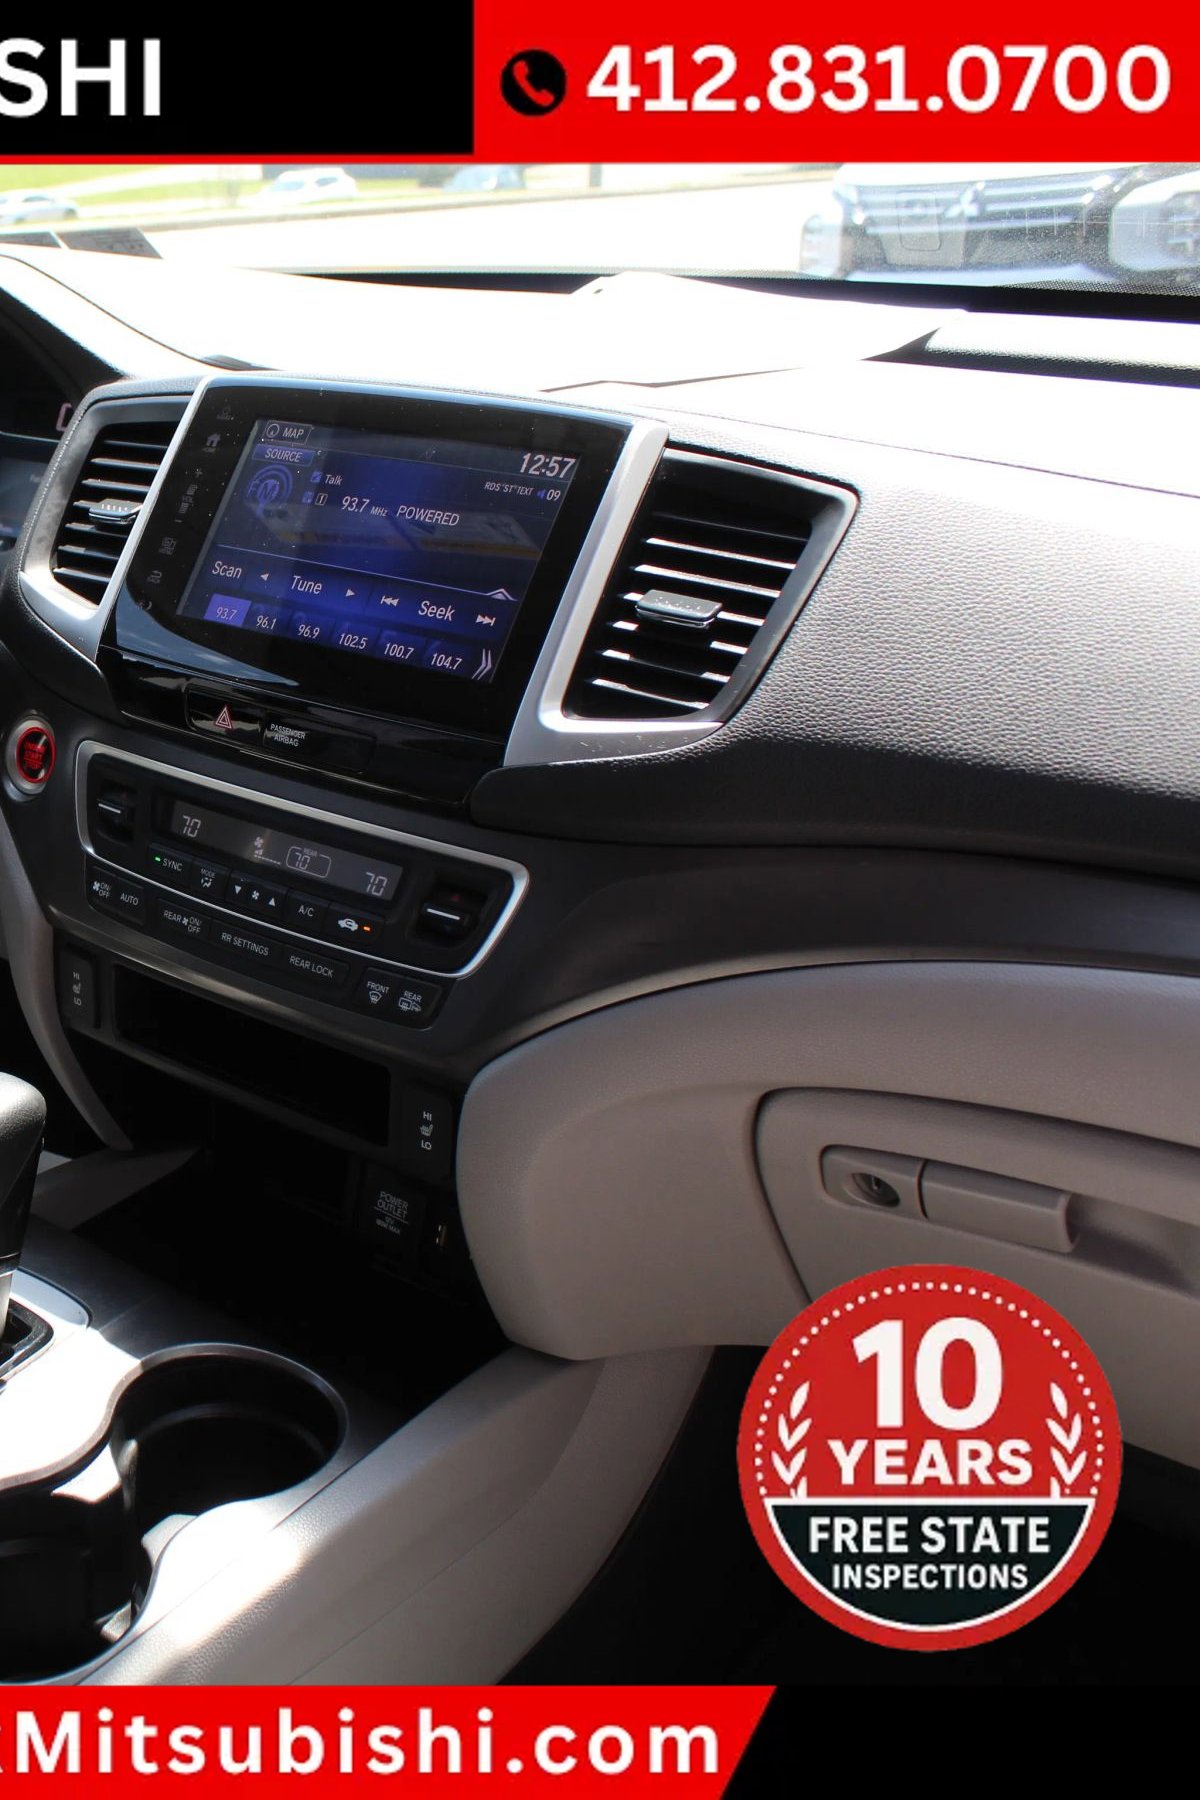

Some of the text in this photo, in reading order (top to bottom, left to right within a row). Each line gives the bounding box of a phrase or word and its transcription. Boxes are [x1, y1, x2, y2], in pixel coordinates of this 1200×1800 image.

[282, 427, 304, 439] MAP
[265, 448, 304, 463] SOURCE
[519, 452, 576, 479] 12:57
[324, 474, 343, 486] Talk
[546, 489, 561, 501] 09
[341, 496, 369, 513] 93.7
[370, 506, 389, 517] MHz
[397, 505, 460, 527] POWERED
[212, 560, 243, 580] Scan
[290, 575, 323, 596] Tune
[215, 606, 238, 621] 93.7
[418, 600, 456, 622] Seek
[256, 615, 277, 630] 96.1
[298, 624, 321, 639] 96.9
[339, 633, 369, 650] 102.5
[383, 642, 414, 660] 100.7
[430, 652, 464, 671] 104.7
[270, 723, 306, 739] PASSENGER
[274, 733, 299, 747] AIRBAG
[182, 815, 201, 838] 70
[162, 858, 183, 872] SYNC
[295, 852, 310, 870] 70
[200, 868, 216, 879] MODE
[365, 872, 387, 896] 70
[98, 889, 111, 899] OFF
[120, 893, 139, 906] AUTO
[163, 910, 182, 923] REAR
[298, 905, 316, 918] A/C
[187, 924, 201, 934] OFF
[221, 932, 269, 957] RR SETTINGS
[289, 955, 335, 979] REAR LOCK
[366, 980, 390, 994] FRONT
[403, 990, 422, 1002] REAR
